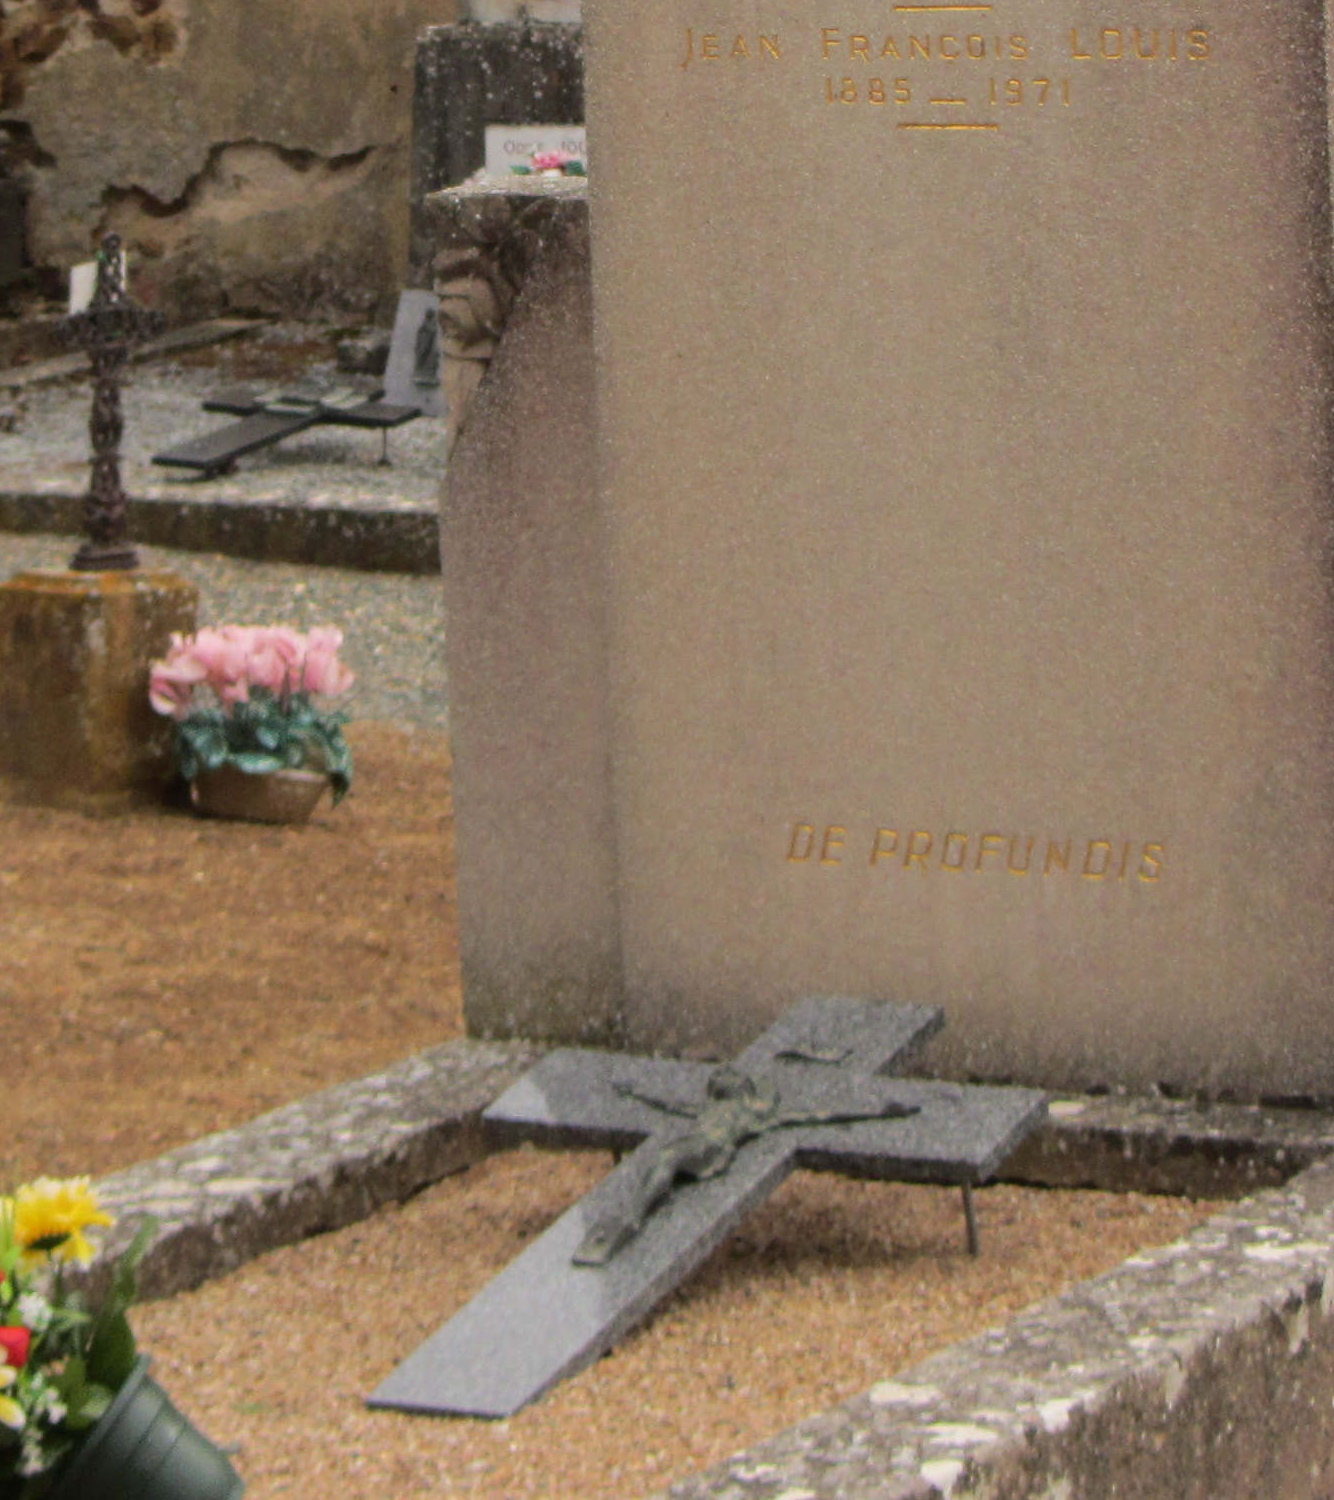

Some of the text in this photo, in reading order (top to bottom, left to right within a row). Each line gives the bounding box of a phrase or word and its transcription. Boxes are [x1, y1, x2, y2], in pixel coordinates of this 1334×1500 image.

[680, 28, 781, 71] JEAN
[1070, 28, 1210, 61] LOUIS
[825, 77, 911, 106] 1885
[989, 77, 1070, 106] 1971
[786, 822, 1165, 883] DE PROFUNDIS
